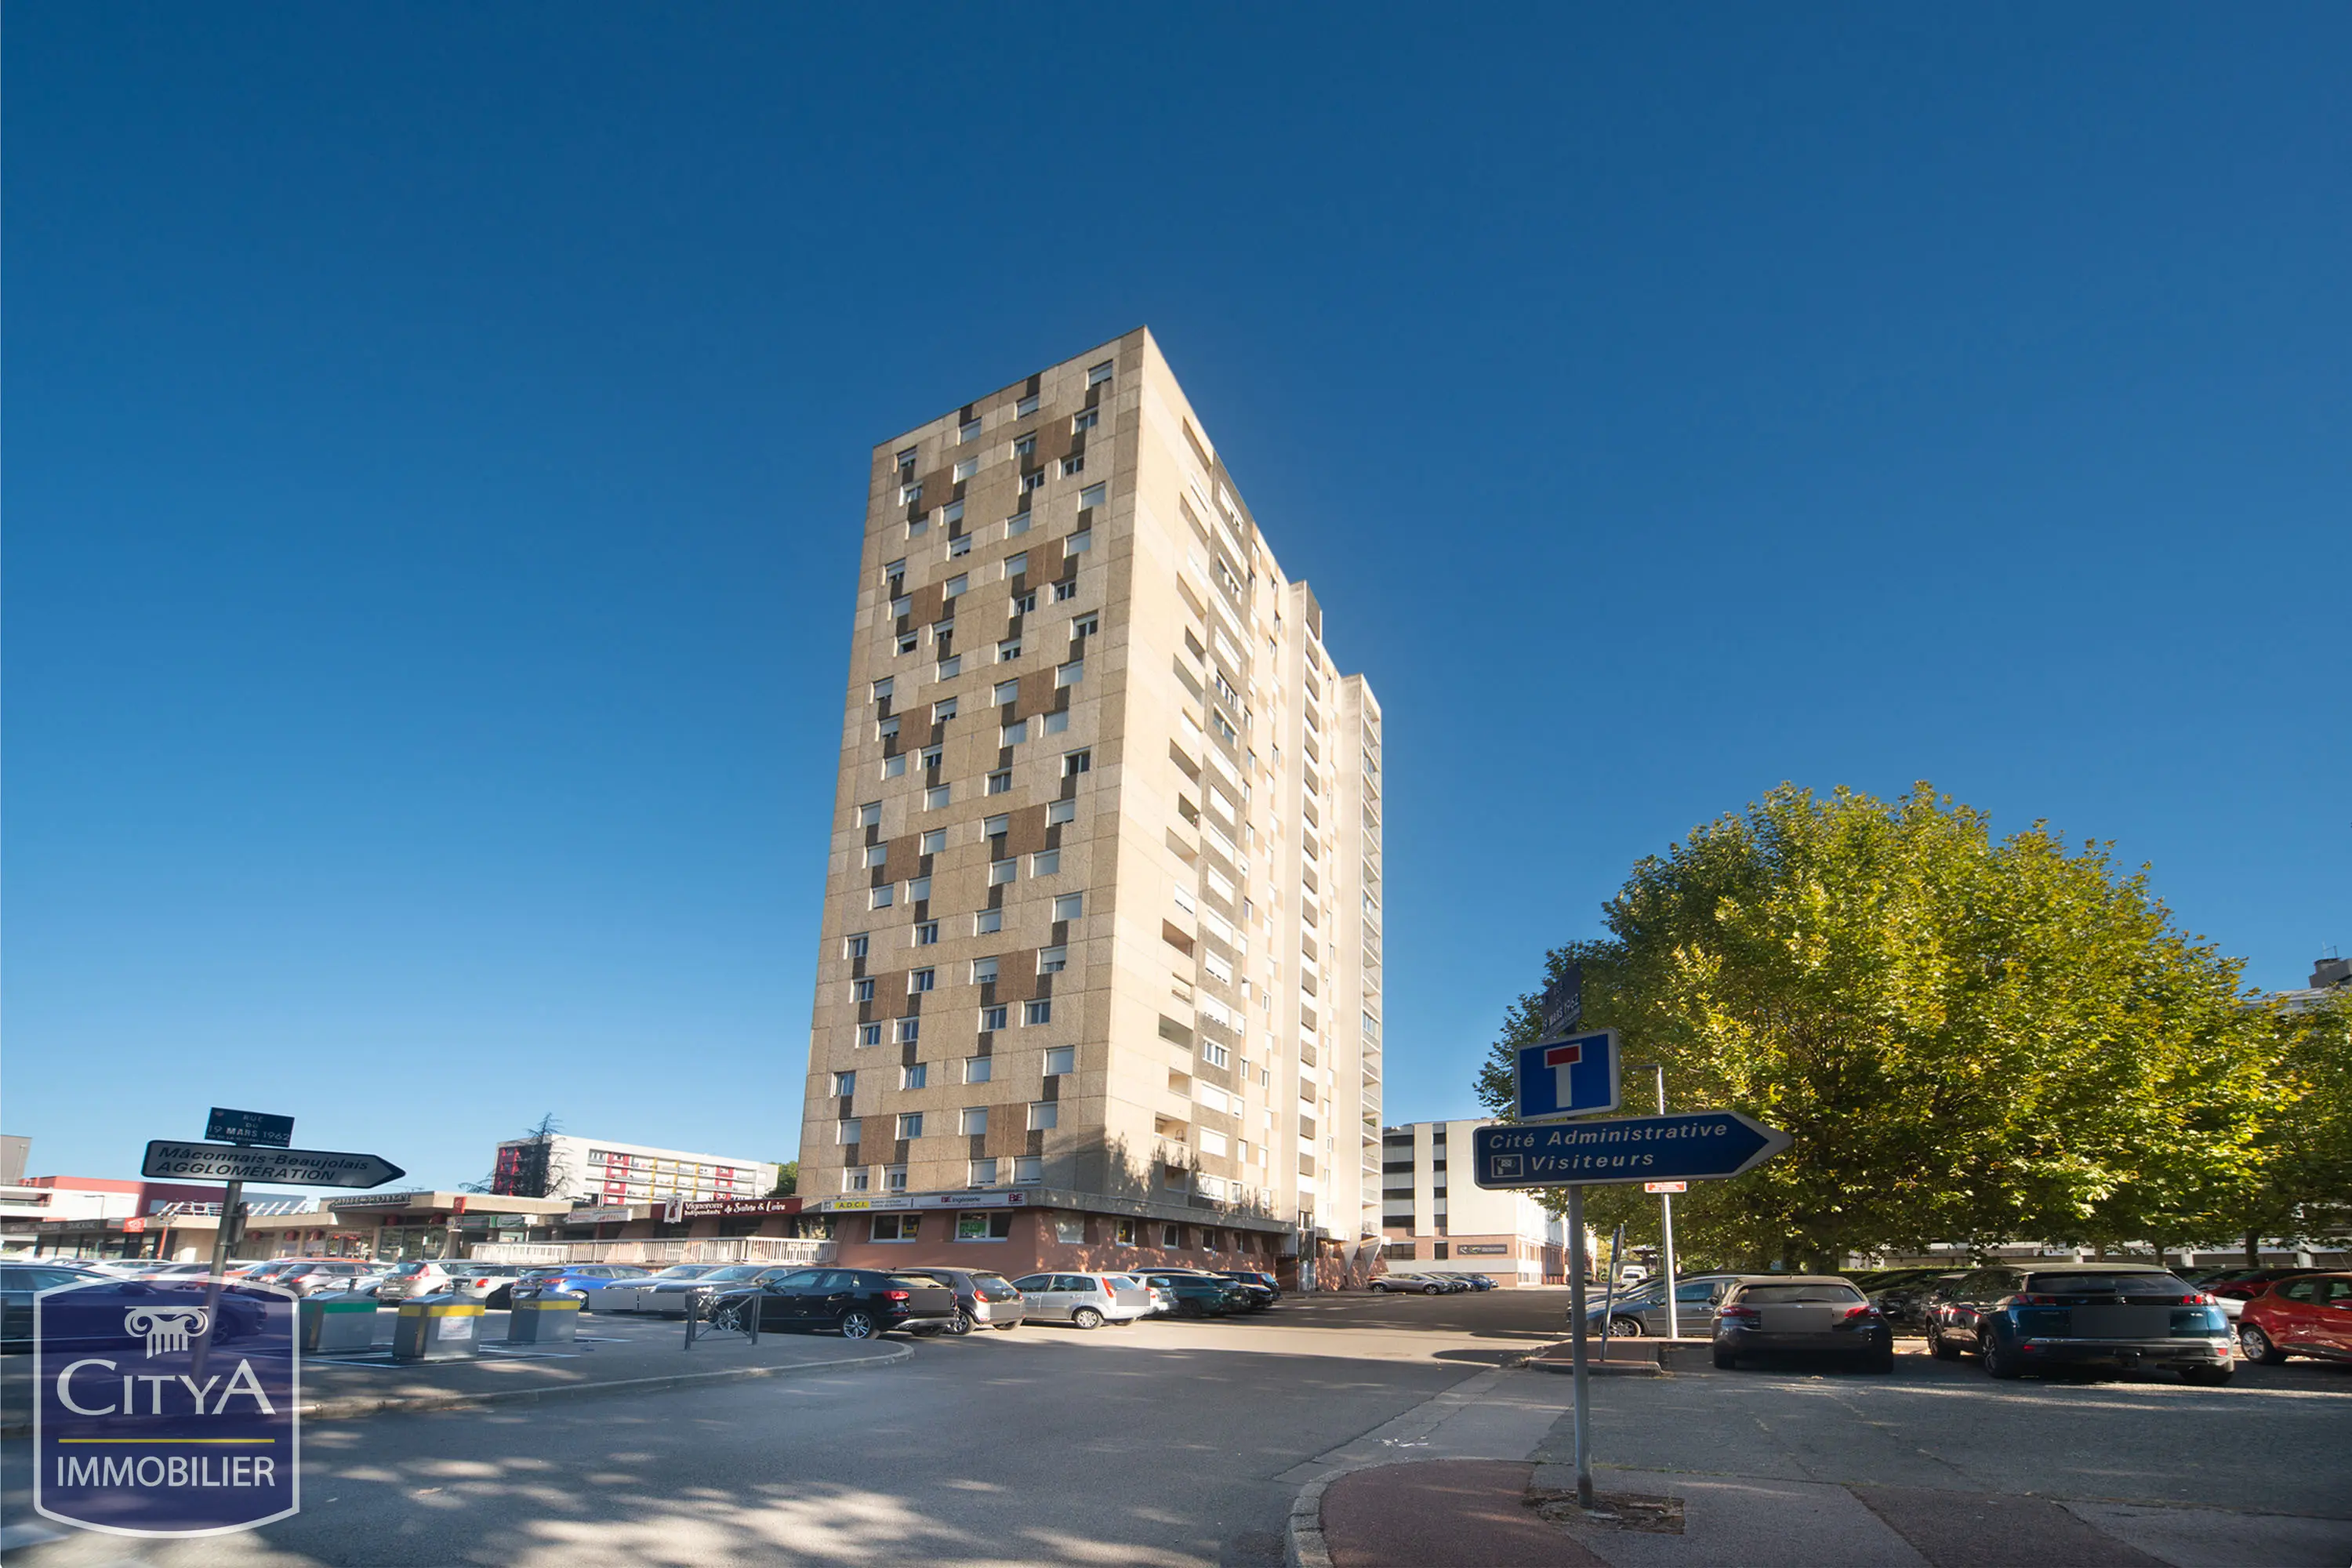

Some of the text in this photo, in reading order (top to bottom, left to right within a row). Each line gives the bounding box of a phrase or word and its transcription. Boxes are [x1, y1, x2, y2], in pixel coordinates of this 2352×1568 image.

[243, 1114, 264, 1123] RUE
[208, 1124, 223, 1134] 19
[226, 1127, 258, 1138] MARS
[263, 1131, 290, 1142] 1962
[1490, 1123, 1728, 1149] Cité Administrative
[158, 1146, 369, 1171] Mâconnais-Beaujolais
[1530, 1152, 1654, 1171] Visiteurs
[156, 1161, 336, 1181] AGGLOMÉRATION
[684, 1202, 723, 1211] Vignerons
